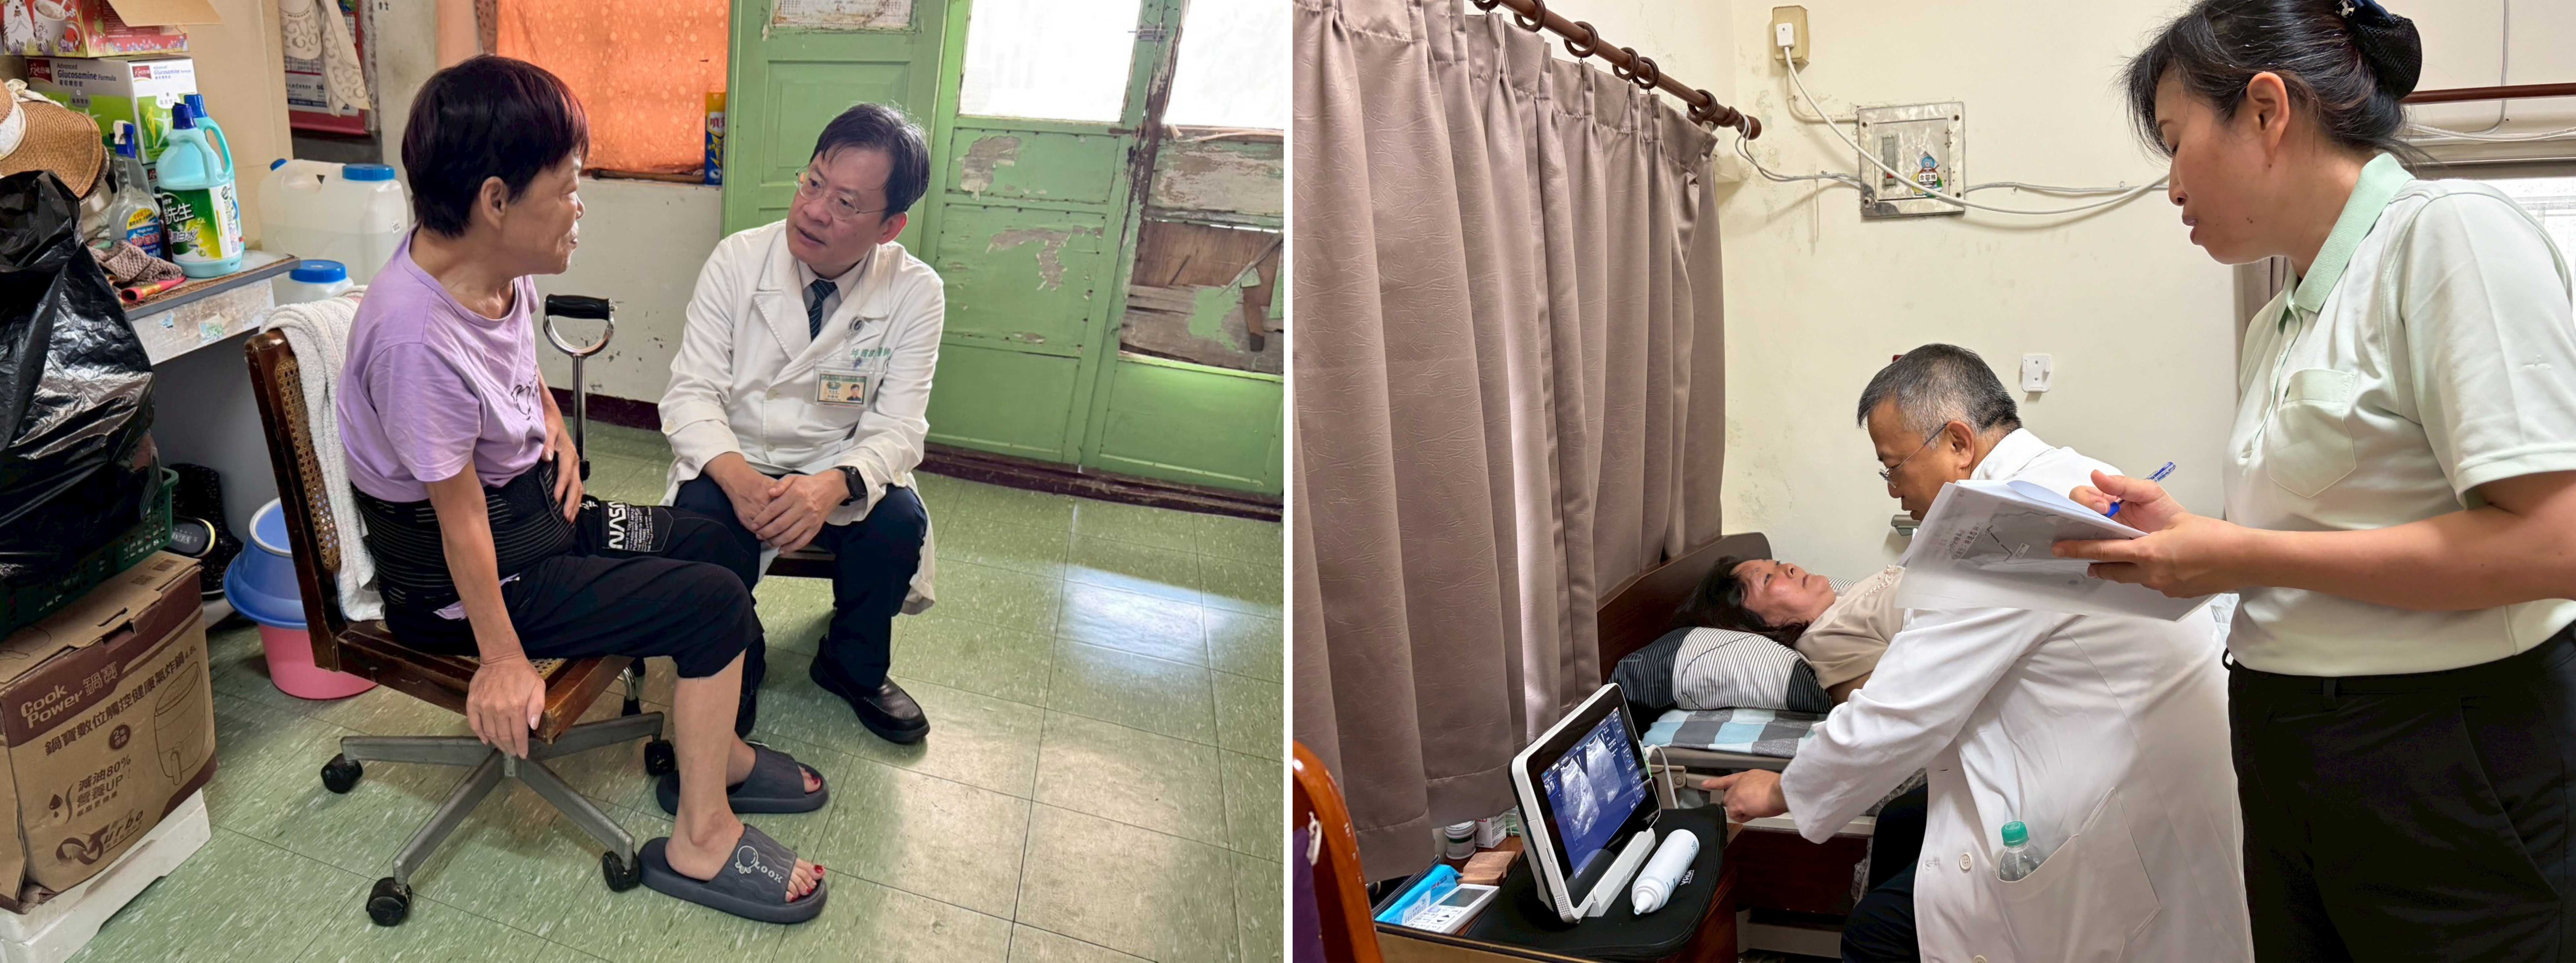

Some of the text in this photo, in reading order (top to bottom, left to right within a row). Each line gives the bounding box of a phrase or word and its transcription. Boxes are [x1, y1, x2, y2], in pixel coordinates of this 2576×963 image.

[57, 69, 97, 80] Glucosamine
[20, 684, 67, 717] Cook
[27, 690, 83, 729] Power
